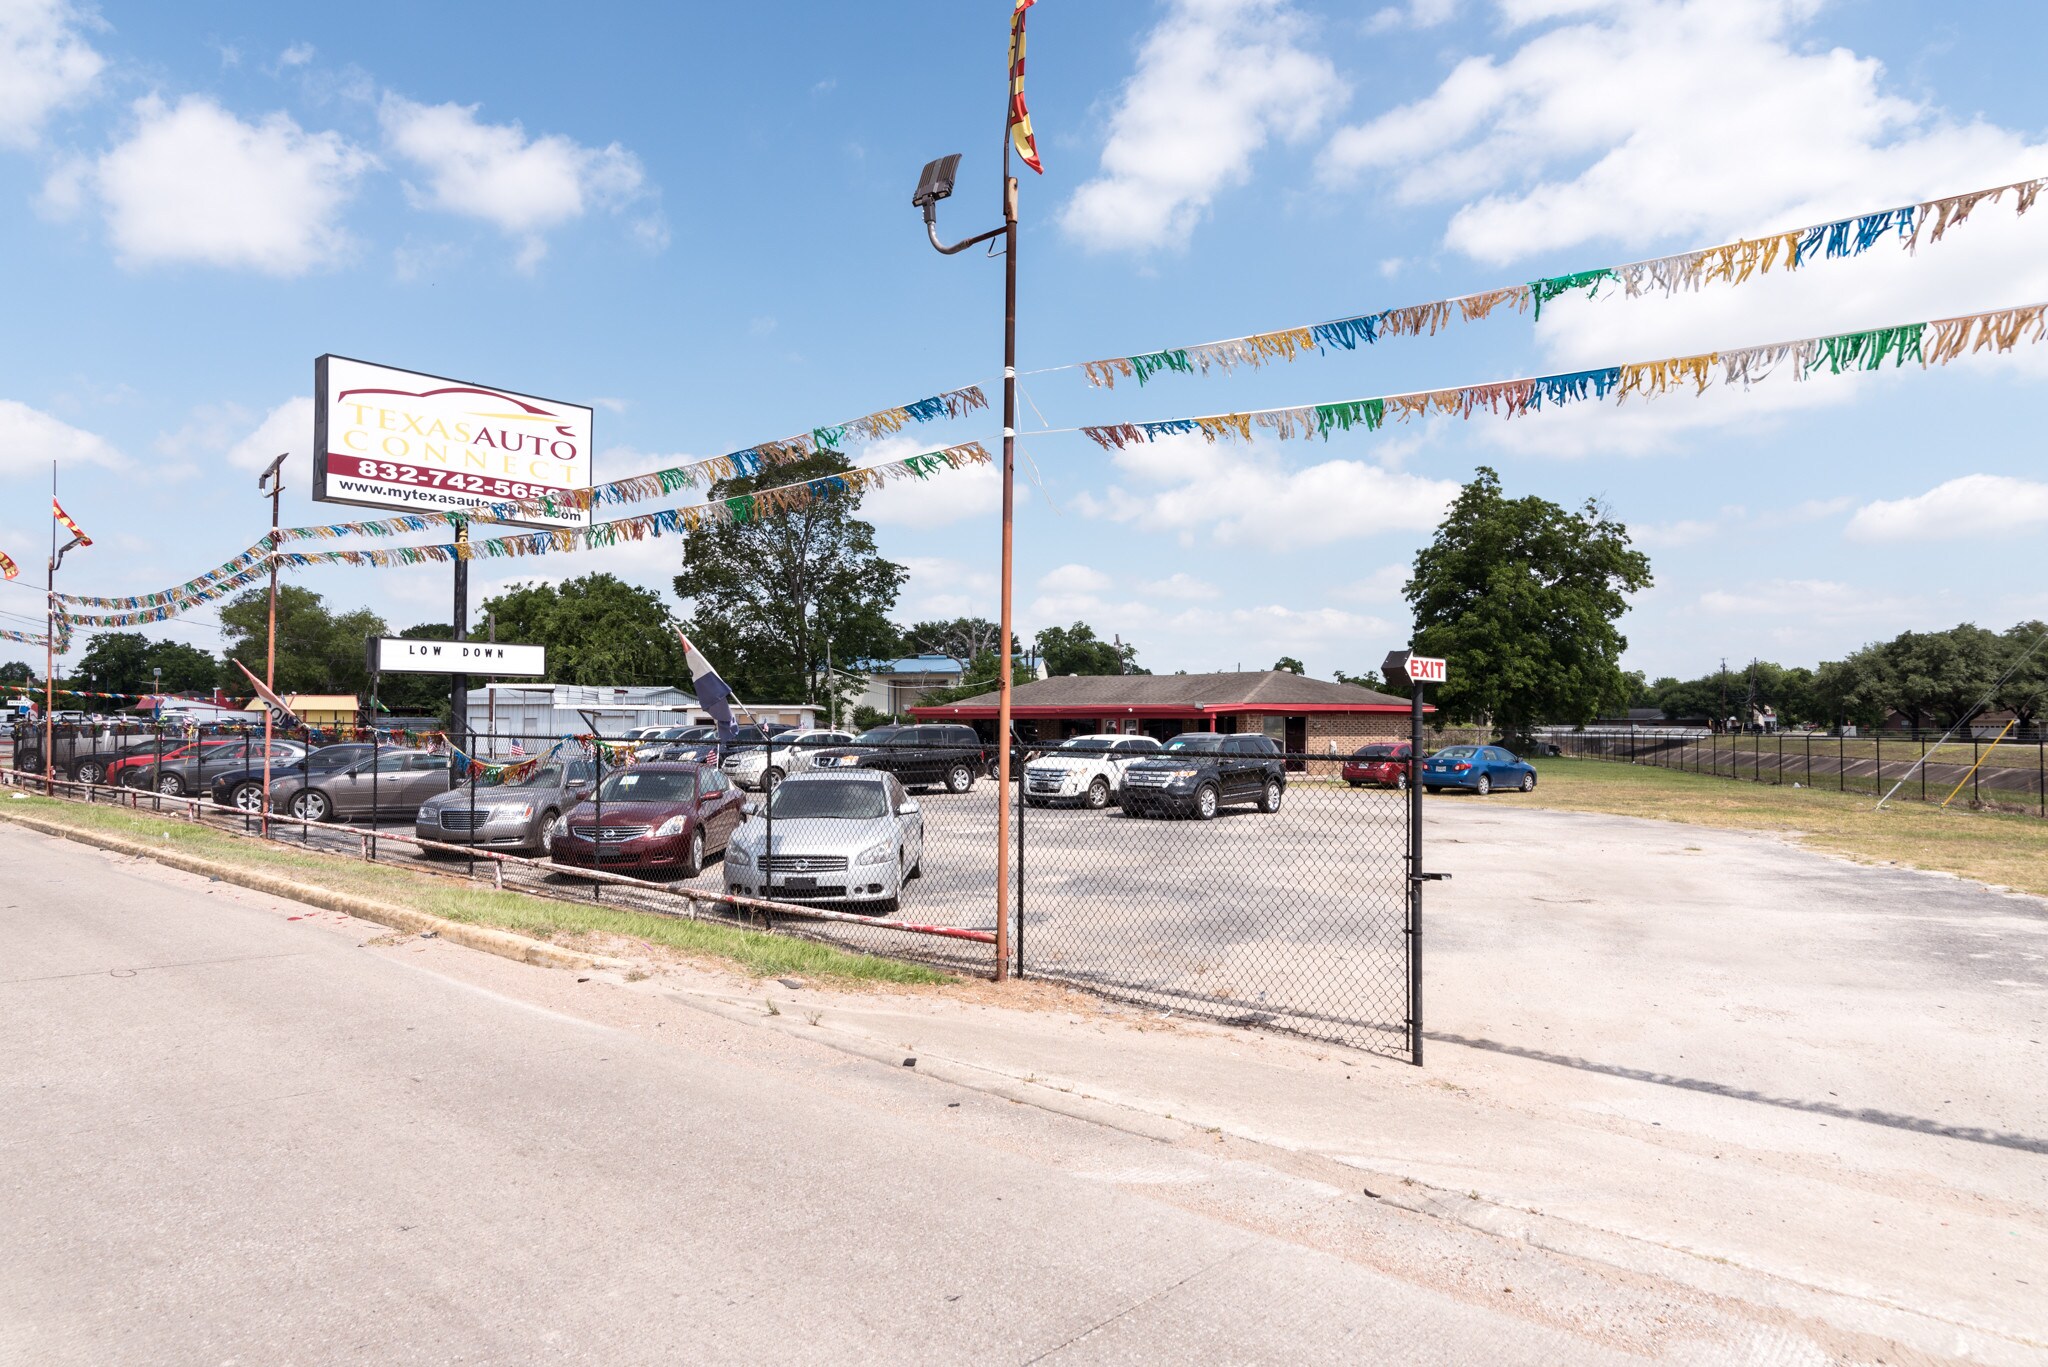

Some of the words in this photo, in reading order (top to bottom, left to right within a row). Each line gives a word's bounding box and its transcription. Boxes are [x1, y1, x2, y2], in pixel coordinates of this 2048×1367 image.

[343, 430, 578, 483] CONNECT
[409, 645, 442, 656] LOW
[463, 647, 504, 658] DOWN
[1410, 659, 1444, 679] EXIT
